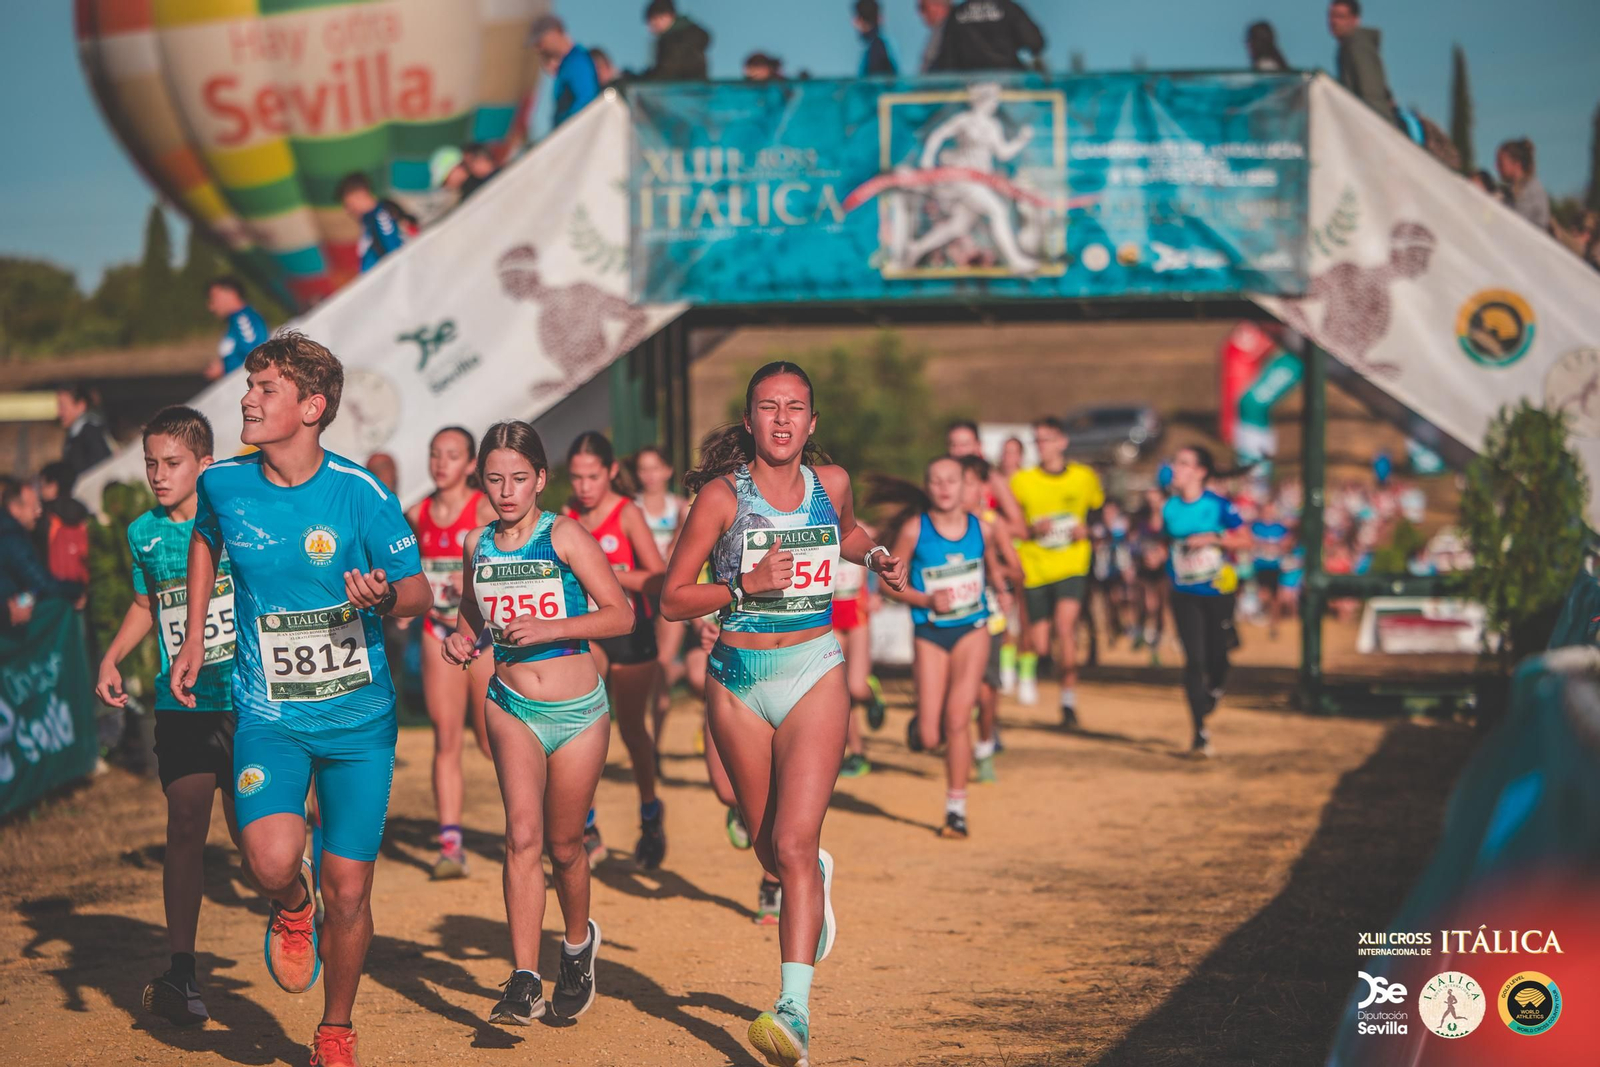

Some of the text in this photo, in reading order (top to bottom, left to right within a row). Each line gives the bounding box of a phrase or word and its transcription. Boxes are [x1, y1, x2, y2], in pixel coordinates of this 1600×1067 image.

[229, 9, 402, 67] Hay otra
[200, 52, 454, 148] Sevilla.
[497, 564, 536, 576] ITÁLICA
[286, 612, 337, 626] ITÁLICA
[483, 592, 559, 624] 7356
[273, 636, 361, 676] 5812
